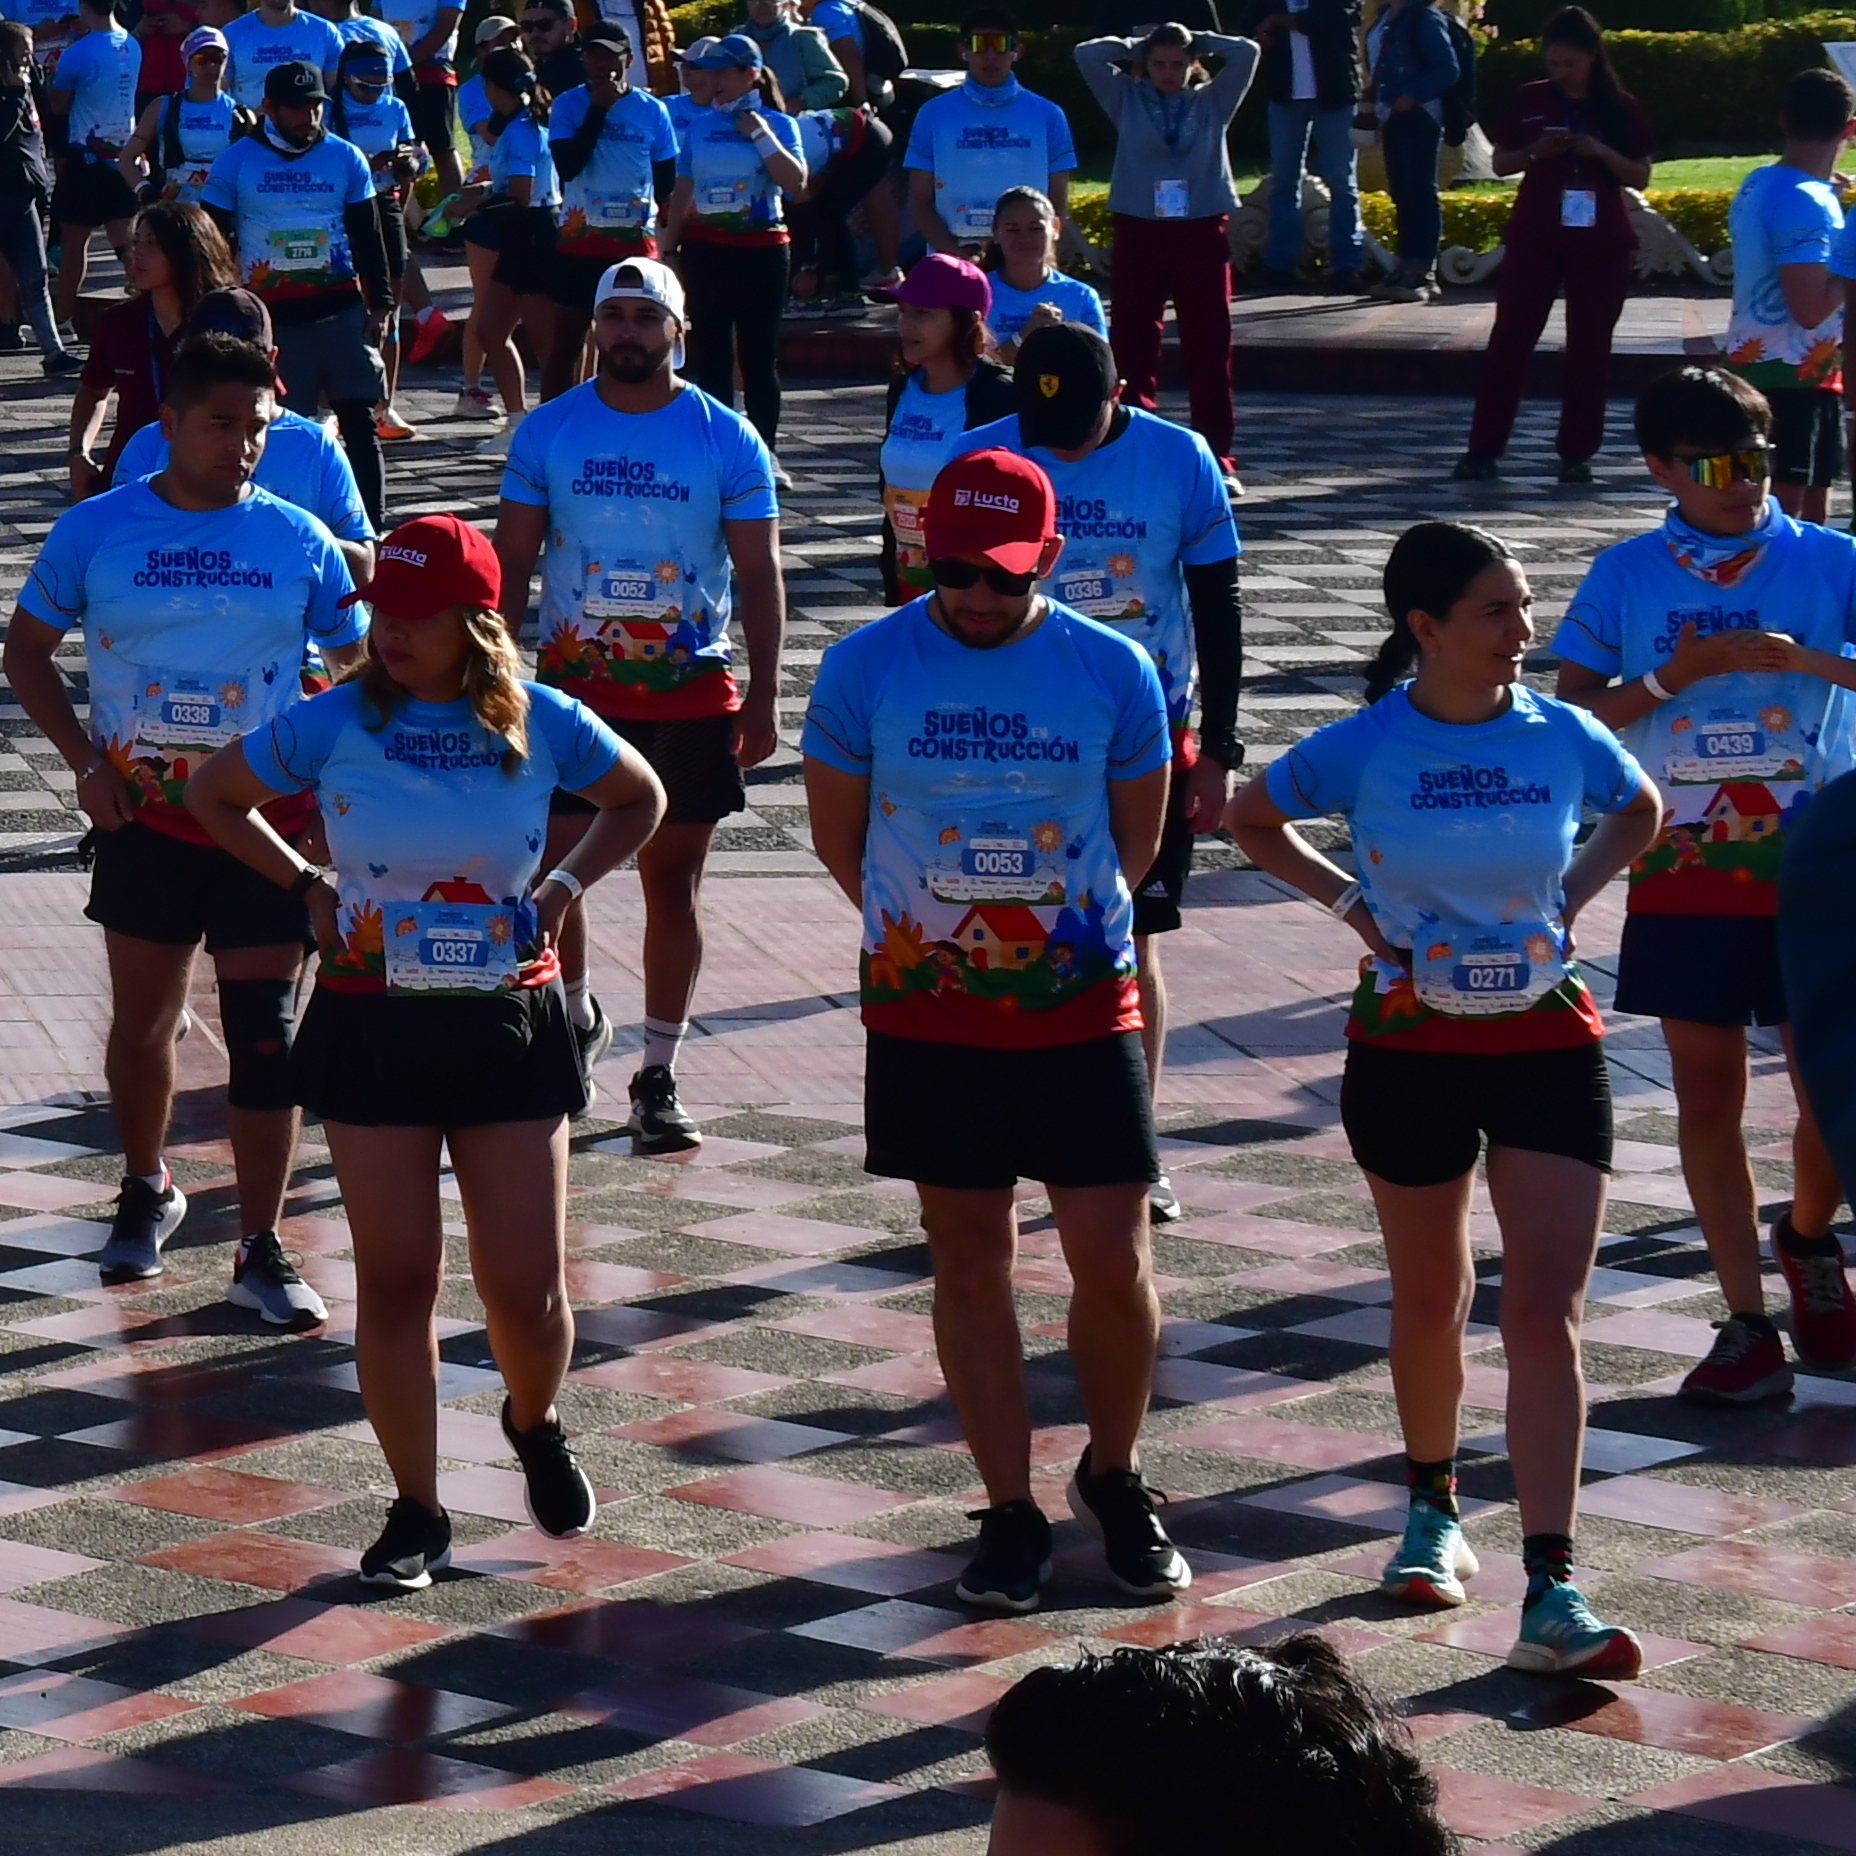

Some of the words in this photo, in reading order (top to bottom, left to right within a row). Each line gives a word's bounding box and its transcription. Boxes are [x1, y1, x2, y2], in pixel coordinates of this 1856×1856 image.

[582, 456, 656, 482] SUEÑOS
[571, 480, 690, 503] CONSTRUCCIÓN
[974, 491, 1020, 509] Lucta
[146, 546, 232, 571] SUEÑOS
[133, 568, 274, 590] CONSTRUCCIÓN
[609, 581, 647, 598] 0052
[171, 704, 211, 724] 0338
[924, 706, 1029, 740] SUEÑOS
[394, 730, 472, 755] SUEÑOS
[908, 736, 1080, 763] CONSTRUCCIÓN
[1706, 734, 1755, 755] 0439
[1419, 765, 1509, 794] SUEÑOS
[1410, 783, 1553, 810] CONSTRUCCIÓN
[974, 852, 1025, 874] 0053
[433, 942, 478, 964] 0337
[1468, 966, 1516, 989] 0271
